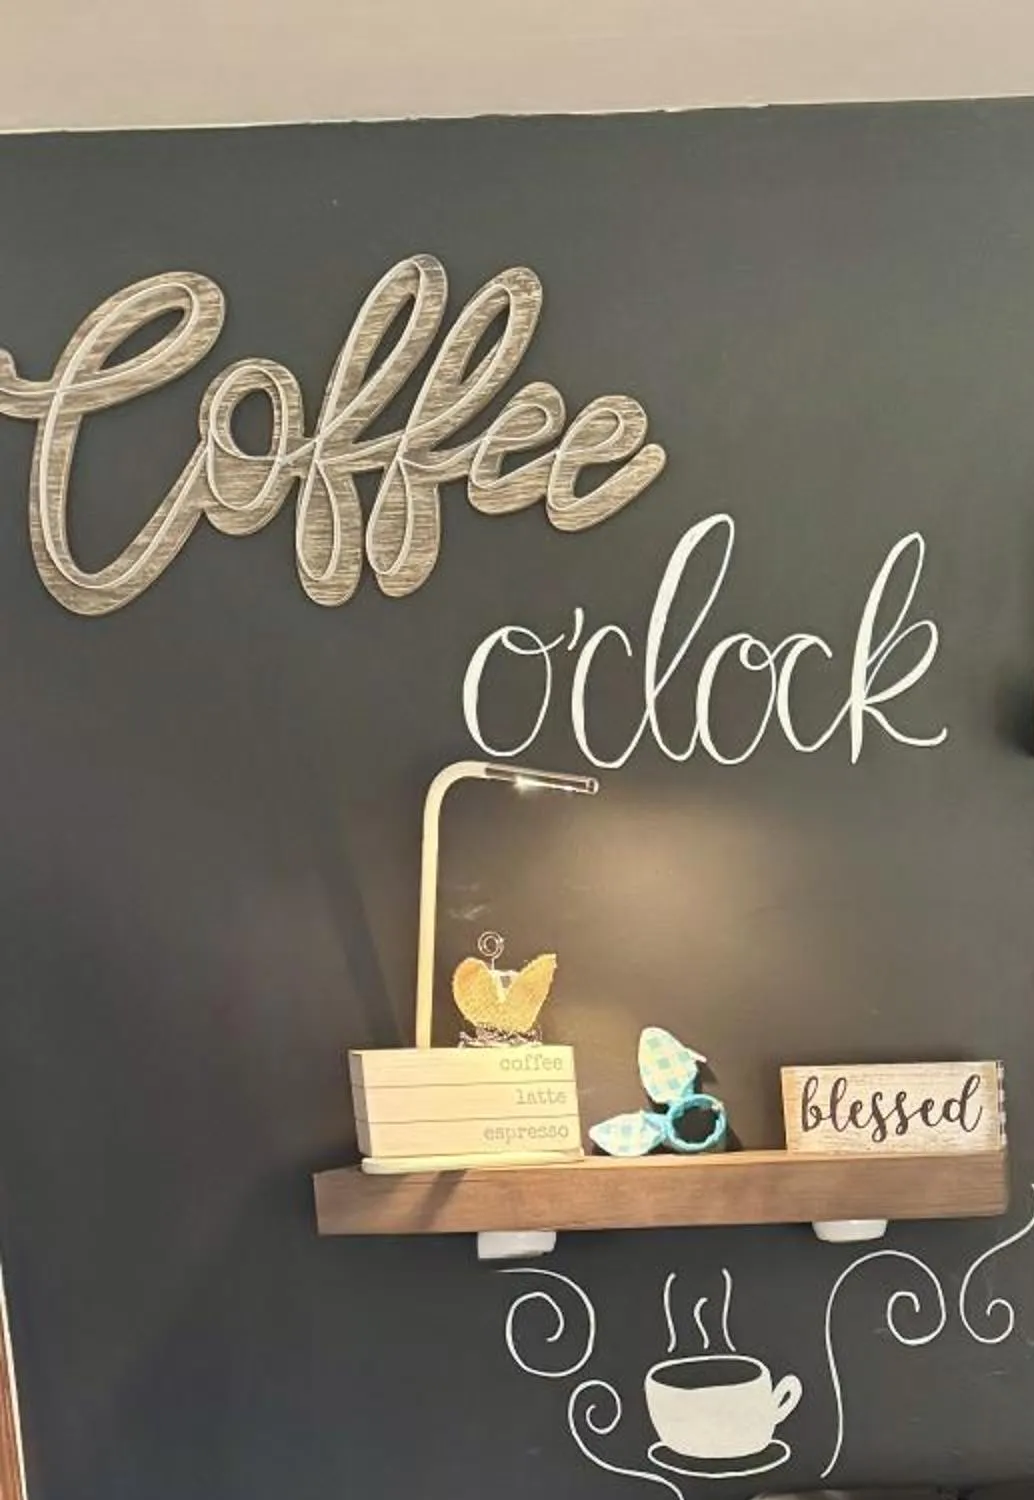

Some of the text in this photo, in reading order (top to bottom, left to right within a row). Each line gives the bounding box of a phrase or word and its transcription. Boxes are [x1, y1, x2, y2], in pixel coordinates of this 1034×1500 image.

[0, 253, 667, 617] Coffee
[462, 513, 948, 769] o'clock
[500, 1053, 563, 1071] coffee
[515, 1088, 567, 1105] latte
[801, 1074, 983, 1143] blessed
[483, 1125, 569, 1145] espresso
